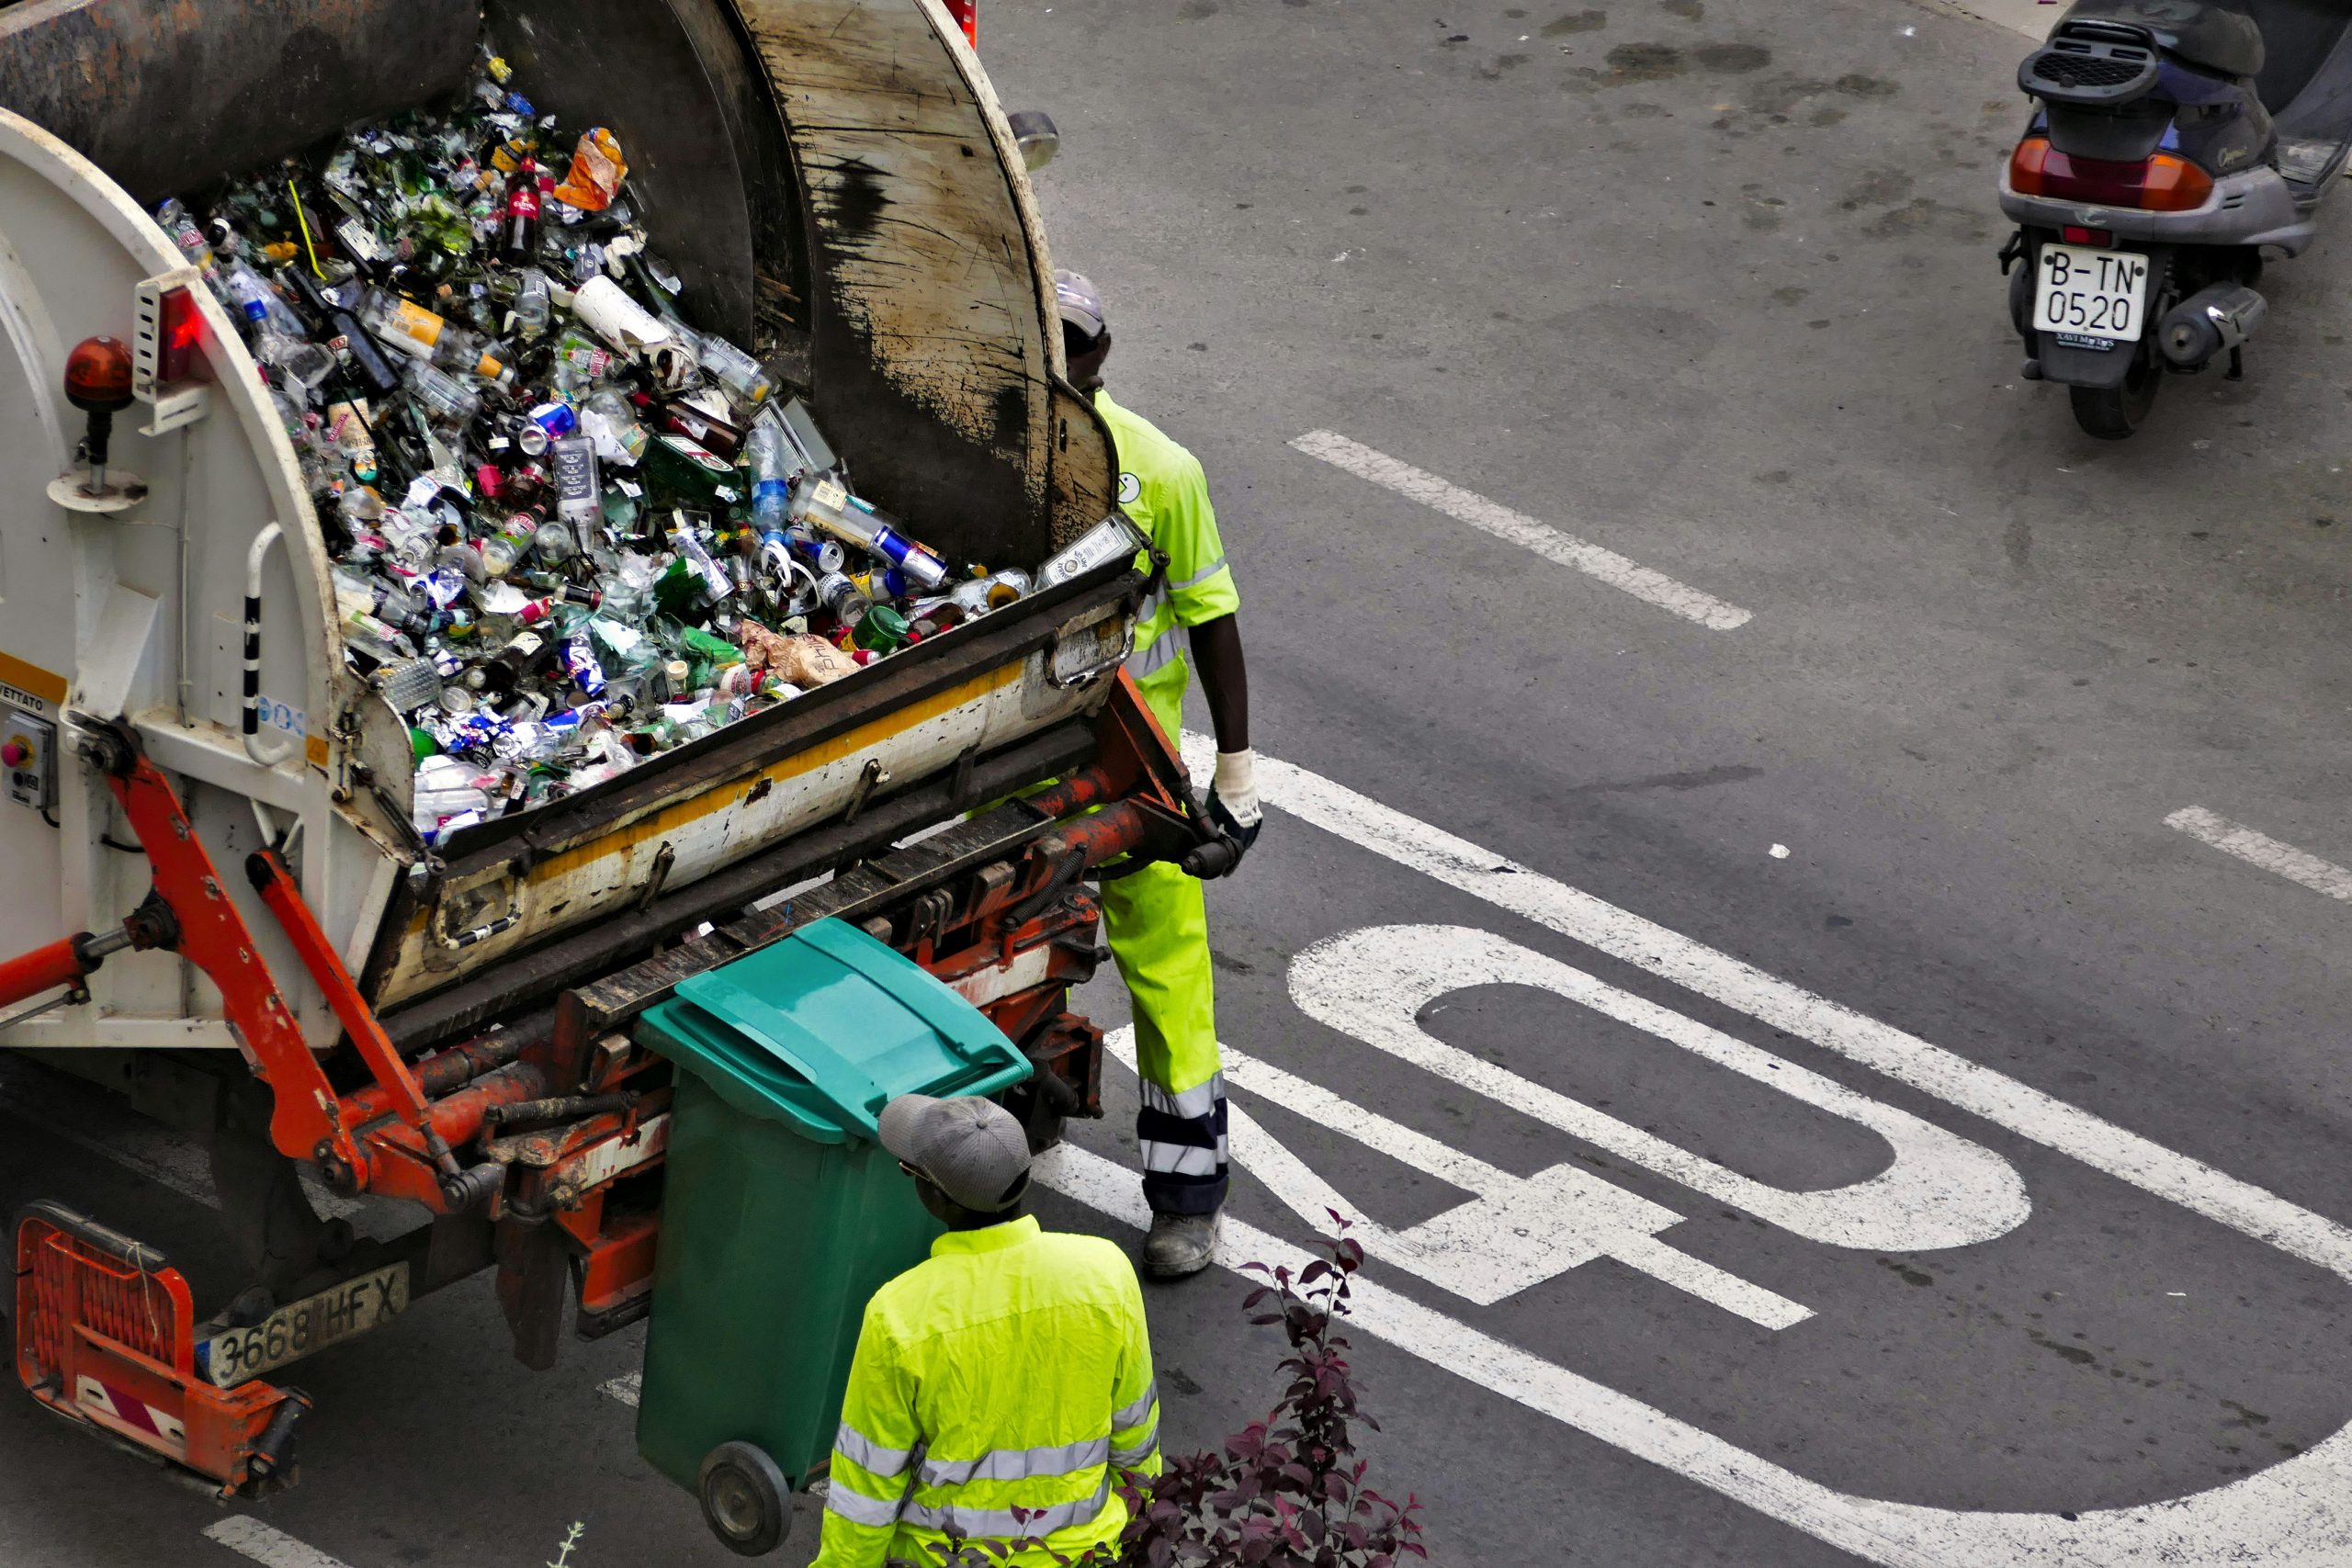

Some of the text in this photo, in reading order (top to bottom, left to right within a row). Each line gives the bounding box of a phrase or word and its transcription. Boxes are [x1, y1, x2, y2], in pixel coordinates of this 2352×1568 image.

[2052, 252, 2134, 294] B-TN
[2048, 291, 2130, 331] 0520
[1103, 923, 2031, 1330] 40
[220, 1270, 397, 1378] 3668 HFX
